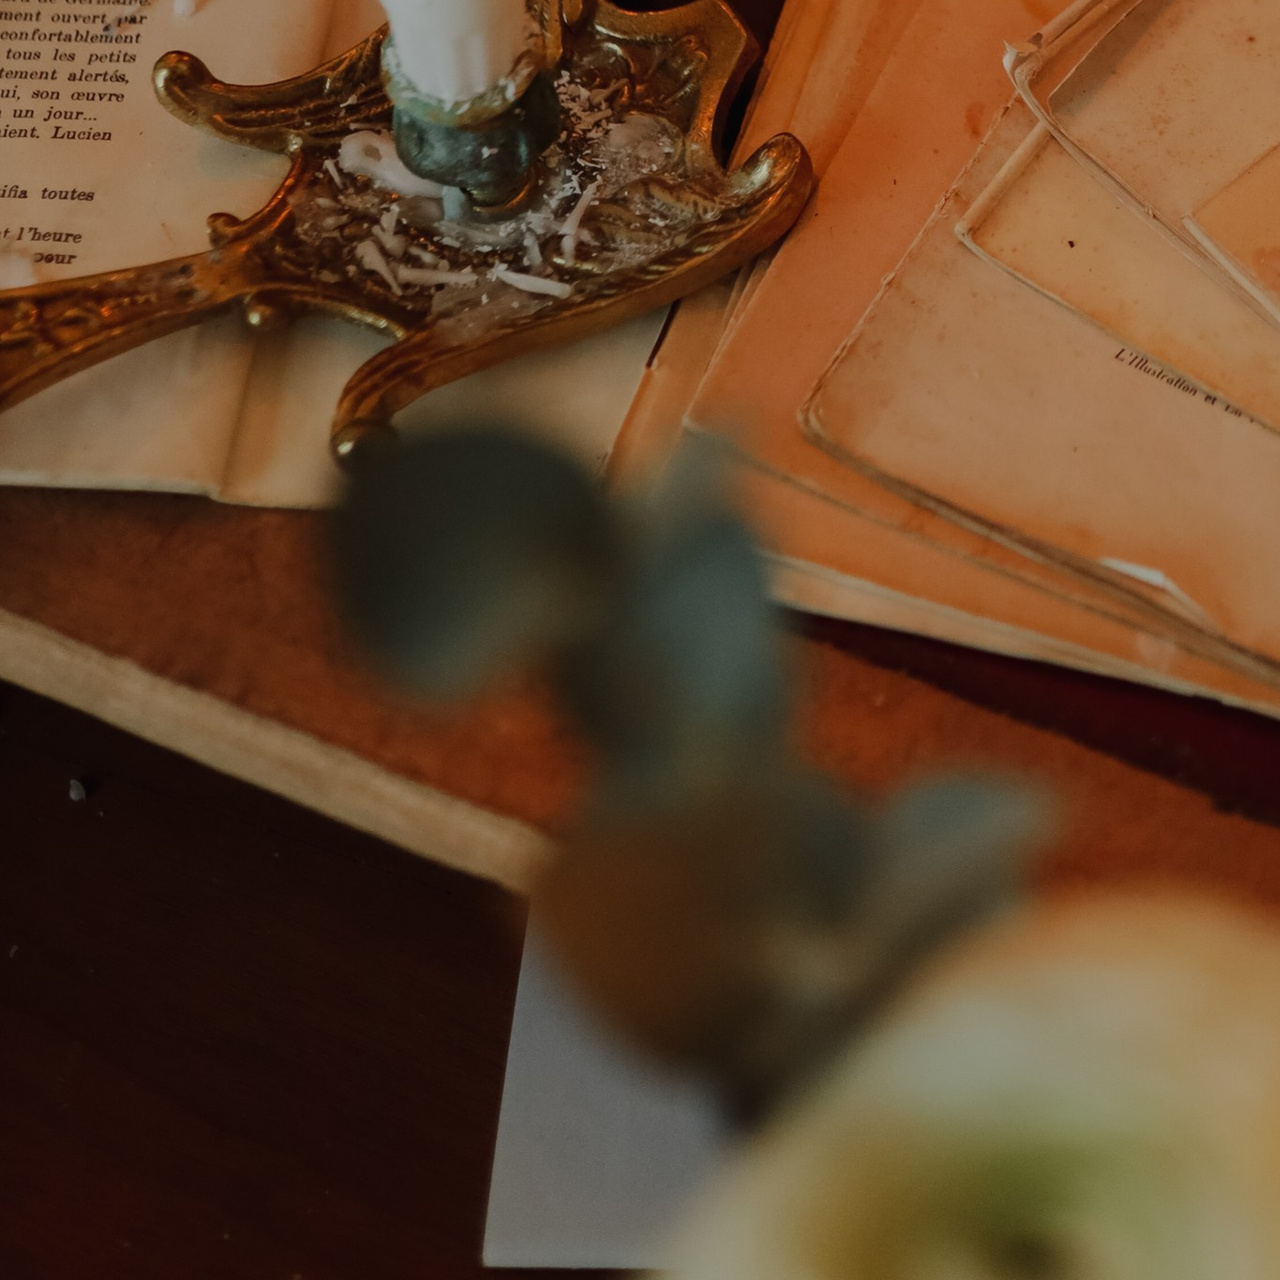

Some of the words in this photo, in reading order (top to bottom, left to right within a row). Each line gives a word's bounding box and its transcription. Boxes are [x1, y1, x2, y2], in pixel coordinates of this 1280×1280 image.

[6, 48, 42, 61] tous
[53, 48, 76, 62] les
[87, 50, 137, 66] petits
[67, 68, 130, 85] alertés,
[31, 89, 61, 101] son
[70, 91, 125, 103] œuvre
[12, 108, 35, 119] un
[0, 124, 40, 139] ient.
[50, 125, 112, 141] Lucien
[41, 187, 96, 202] toutes
[16, 226, 82, 244] l'heure
